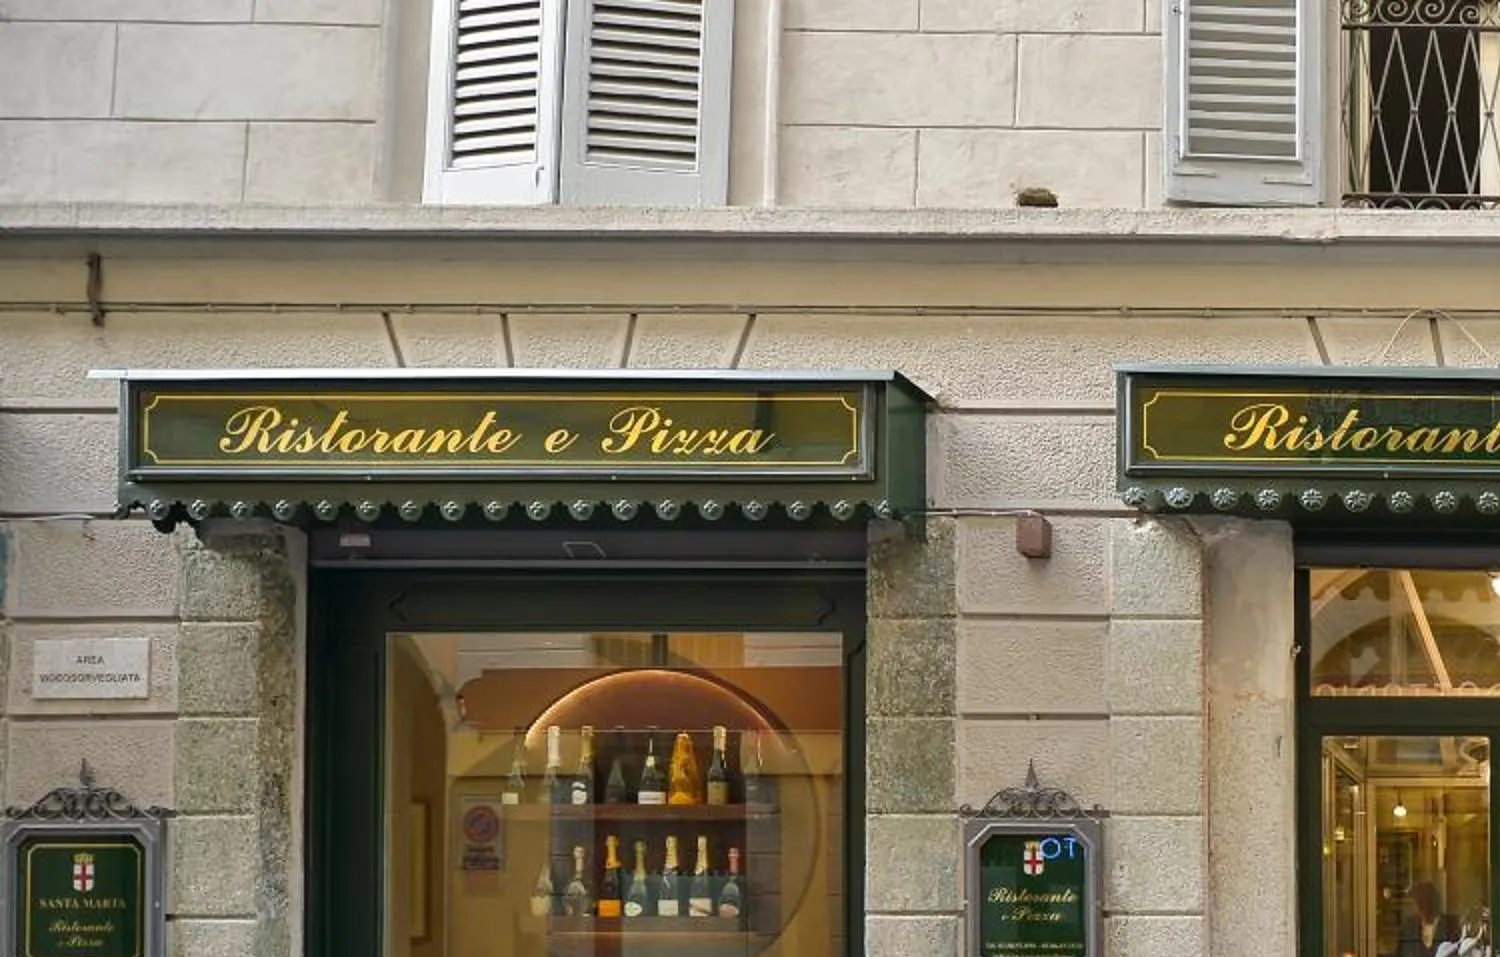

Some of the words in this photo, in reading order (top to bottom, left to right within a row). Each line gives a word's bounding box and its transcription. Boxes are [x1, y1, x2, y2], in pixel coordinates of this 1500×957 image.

[218, 405, 519, 455] Ristorante
[544, 429, 580, 455] e
[600, 405, 778, 455] Pizza
[75, 655, 105, 665] AREA
[987, 887, 1079, 904] Ristorante
[38, 898, 80, 909] SANTA
[83, 898, 126, 909] MARTA
